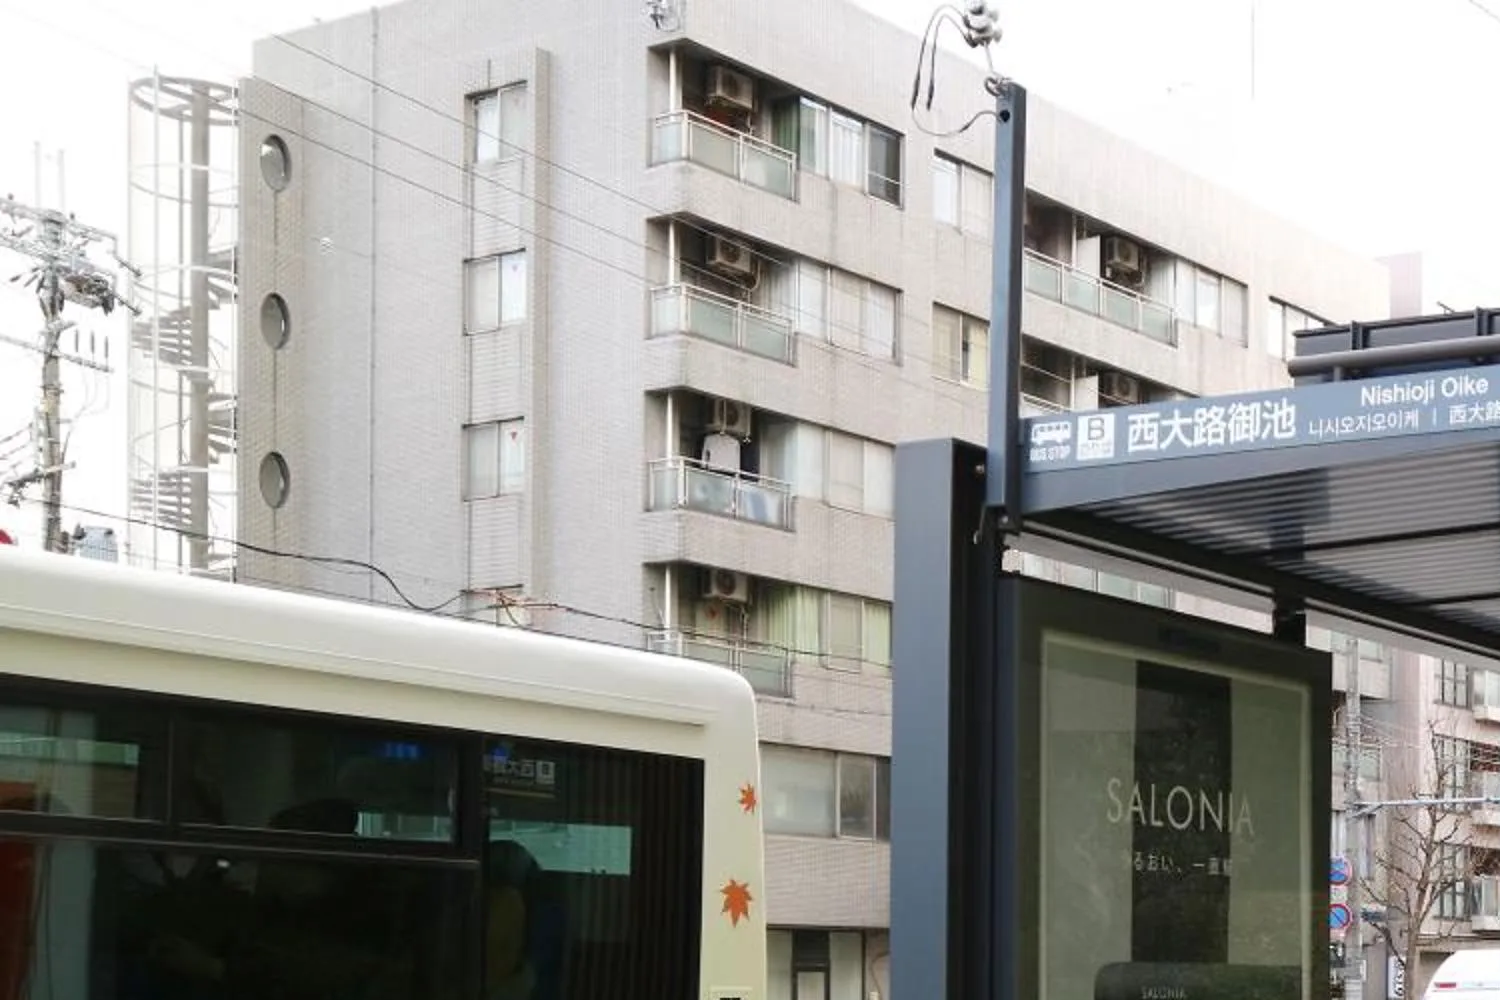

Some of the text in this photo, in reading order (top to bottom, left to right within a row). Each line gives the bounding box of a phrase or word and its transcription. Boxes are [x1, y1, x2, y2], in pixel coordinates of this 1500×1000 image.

[1361, 376, 1489, 407] Nishioji Oike
[1088, 417, 1105, 441] B
[1127, 397, 1297, 455] 西大路御池
[1308, 407, 1419, 437] 니시오지오이케
[1106, 777, 1255, 836] SALONIA
